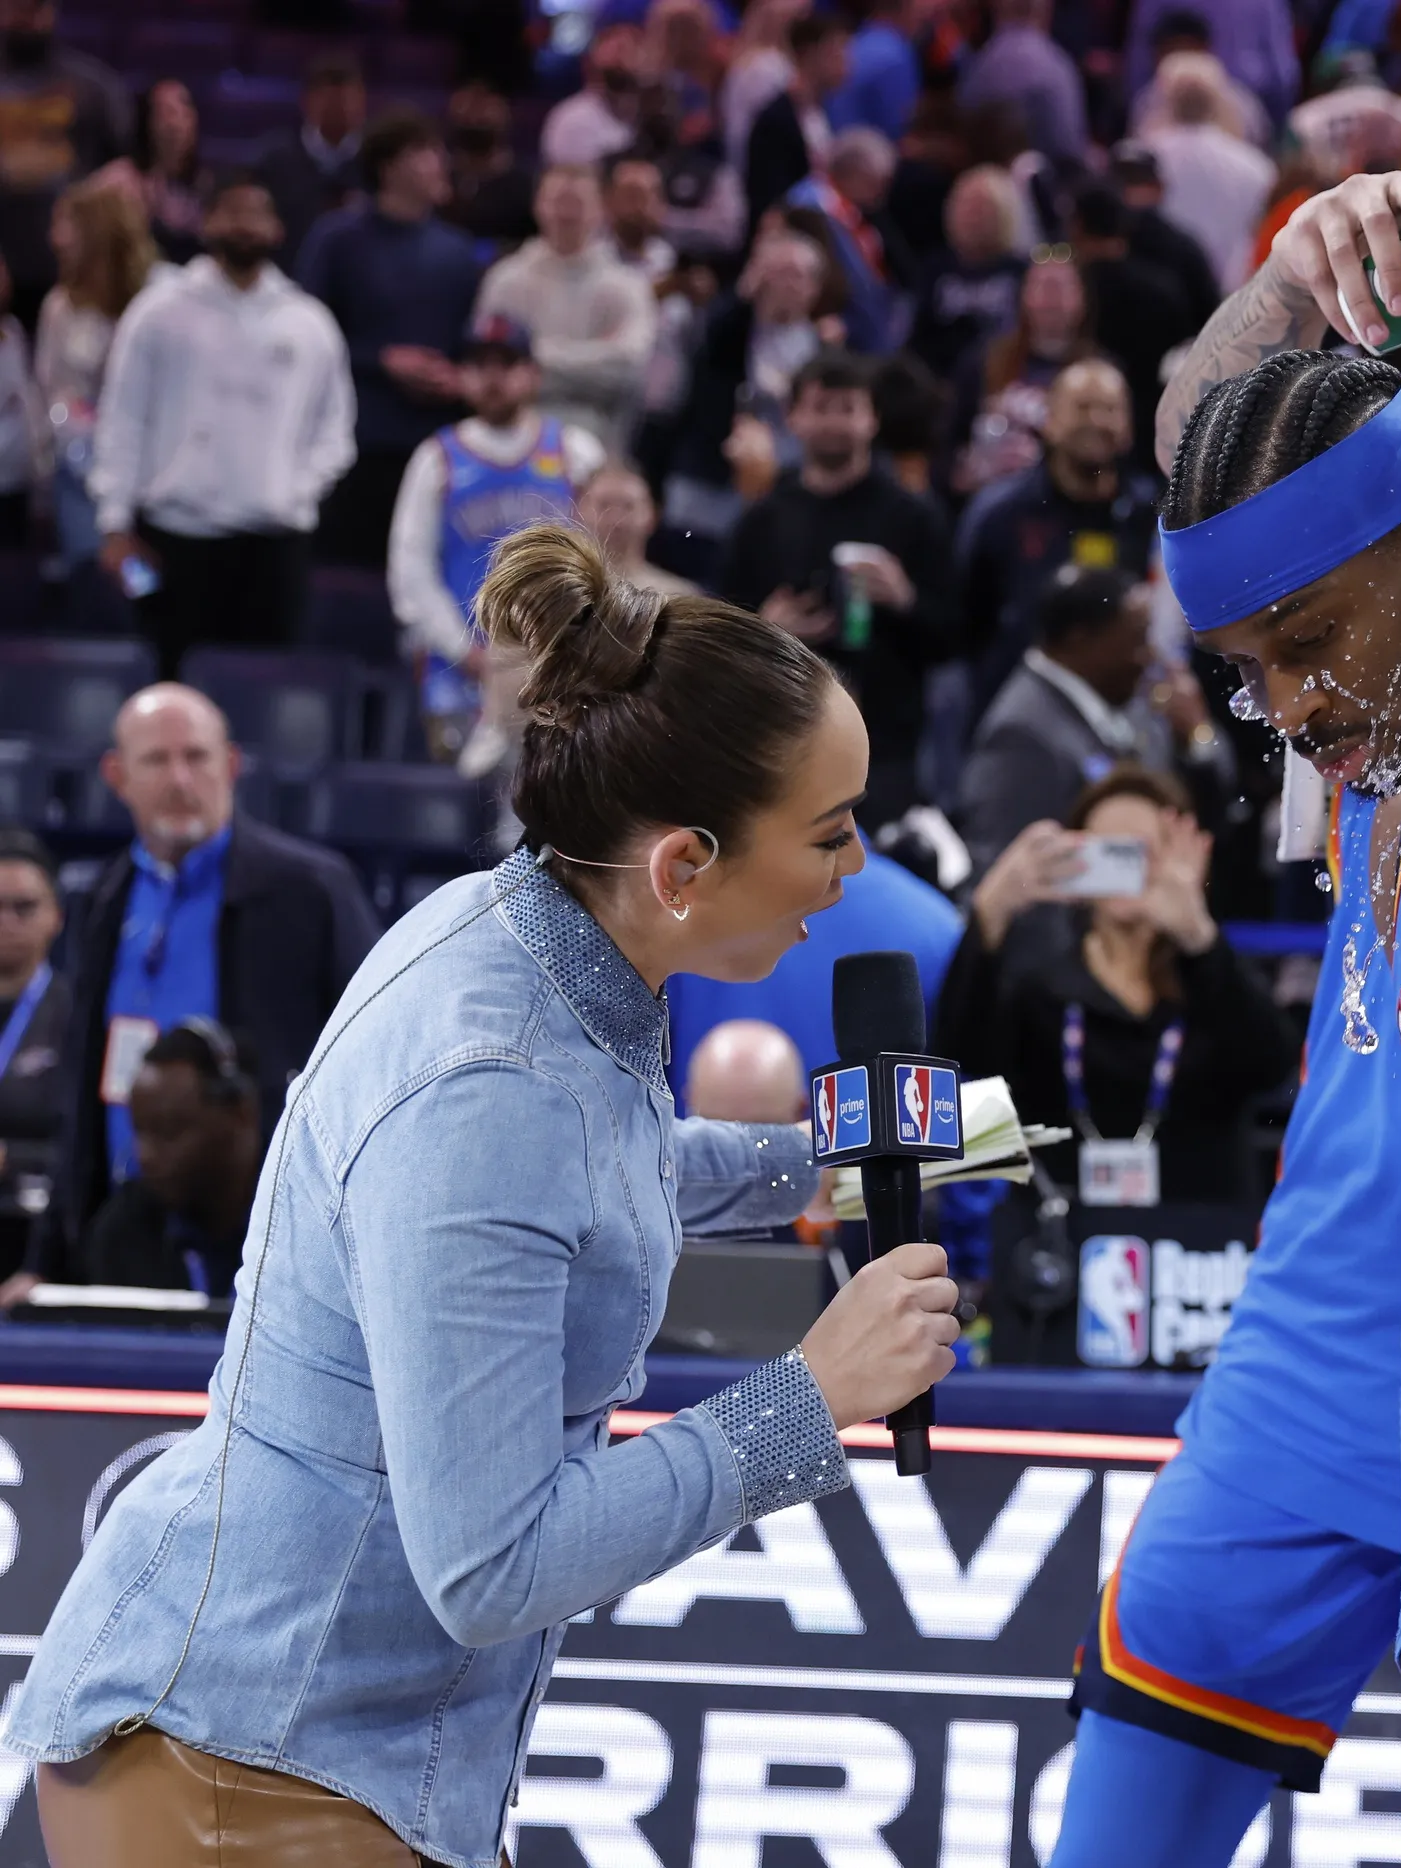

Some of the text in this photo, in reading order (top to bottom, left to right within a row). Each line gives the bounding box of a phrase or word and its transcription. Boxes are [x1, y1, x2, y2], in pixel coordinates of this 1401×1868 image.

[840, 1098, 865, 1118] prime
[934, 1097, 955, 1115] prime
[901, 1122, 916, 1138] NBA
